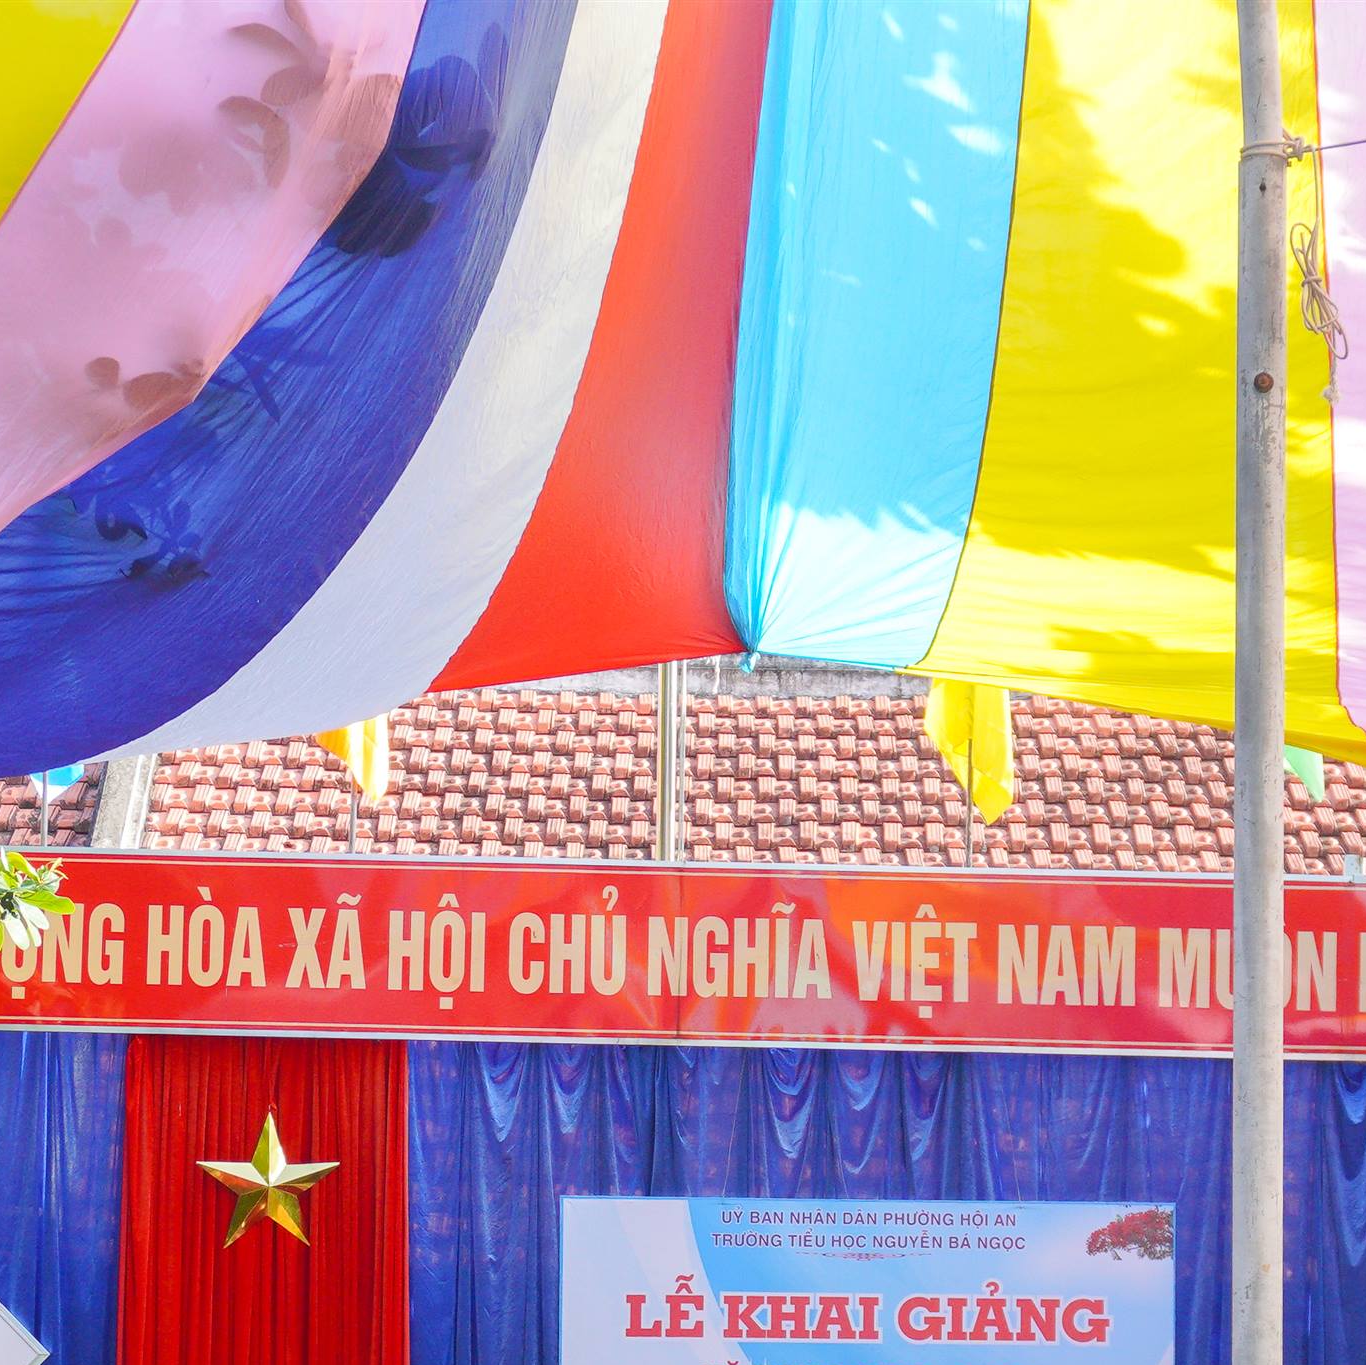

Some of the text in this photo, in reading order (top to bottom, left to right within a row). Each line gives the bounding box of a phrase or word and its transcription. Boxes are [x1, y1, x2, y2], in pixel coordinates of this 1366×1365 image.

[146, 887, 266, 988] HÒA
[286, 893, 366, 990] XÃ
[388, 893, 485, 1010] HỘI
[508, 885, 626, 996] CHỦ
[647, 902, 833, 999] NGHĨA
[852, 904, 977, 1019] VIỆT
[997, 924, 1136, 1006] NAM
[1158, 920, 1337, 1012] MUN
[712, 1228, 1026, 1253] TRƯỜNG TIỂU HỌC NGUYỄN BÁ NGỌC
[750, 1211, 783, 1224] BAN
[790, 1209, 836, 1225] NHÂN
[843, 1209, 877, 1225] DÂN
[884, 1208, 954, 1226] PHƯỜNG
[961, 1210, 988, 1229] HỘI
[994, 1213, 1016, 1226] AN
[625, 1274, 1110, 1342] LỄ KHAI GIẢNG
